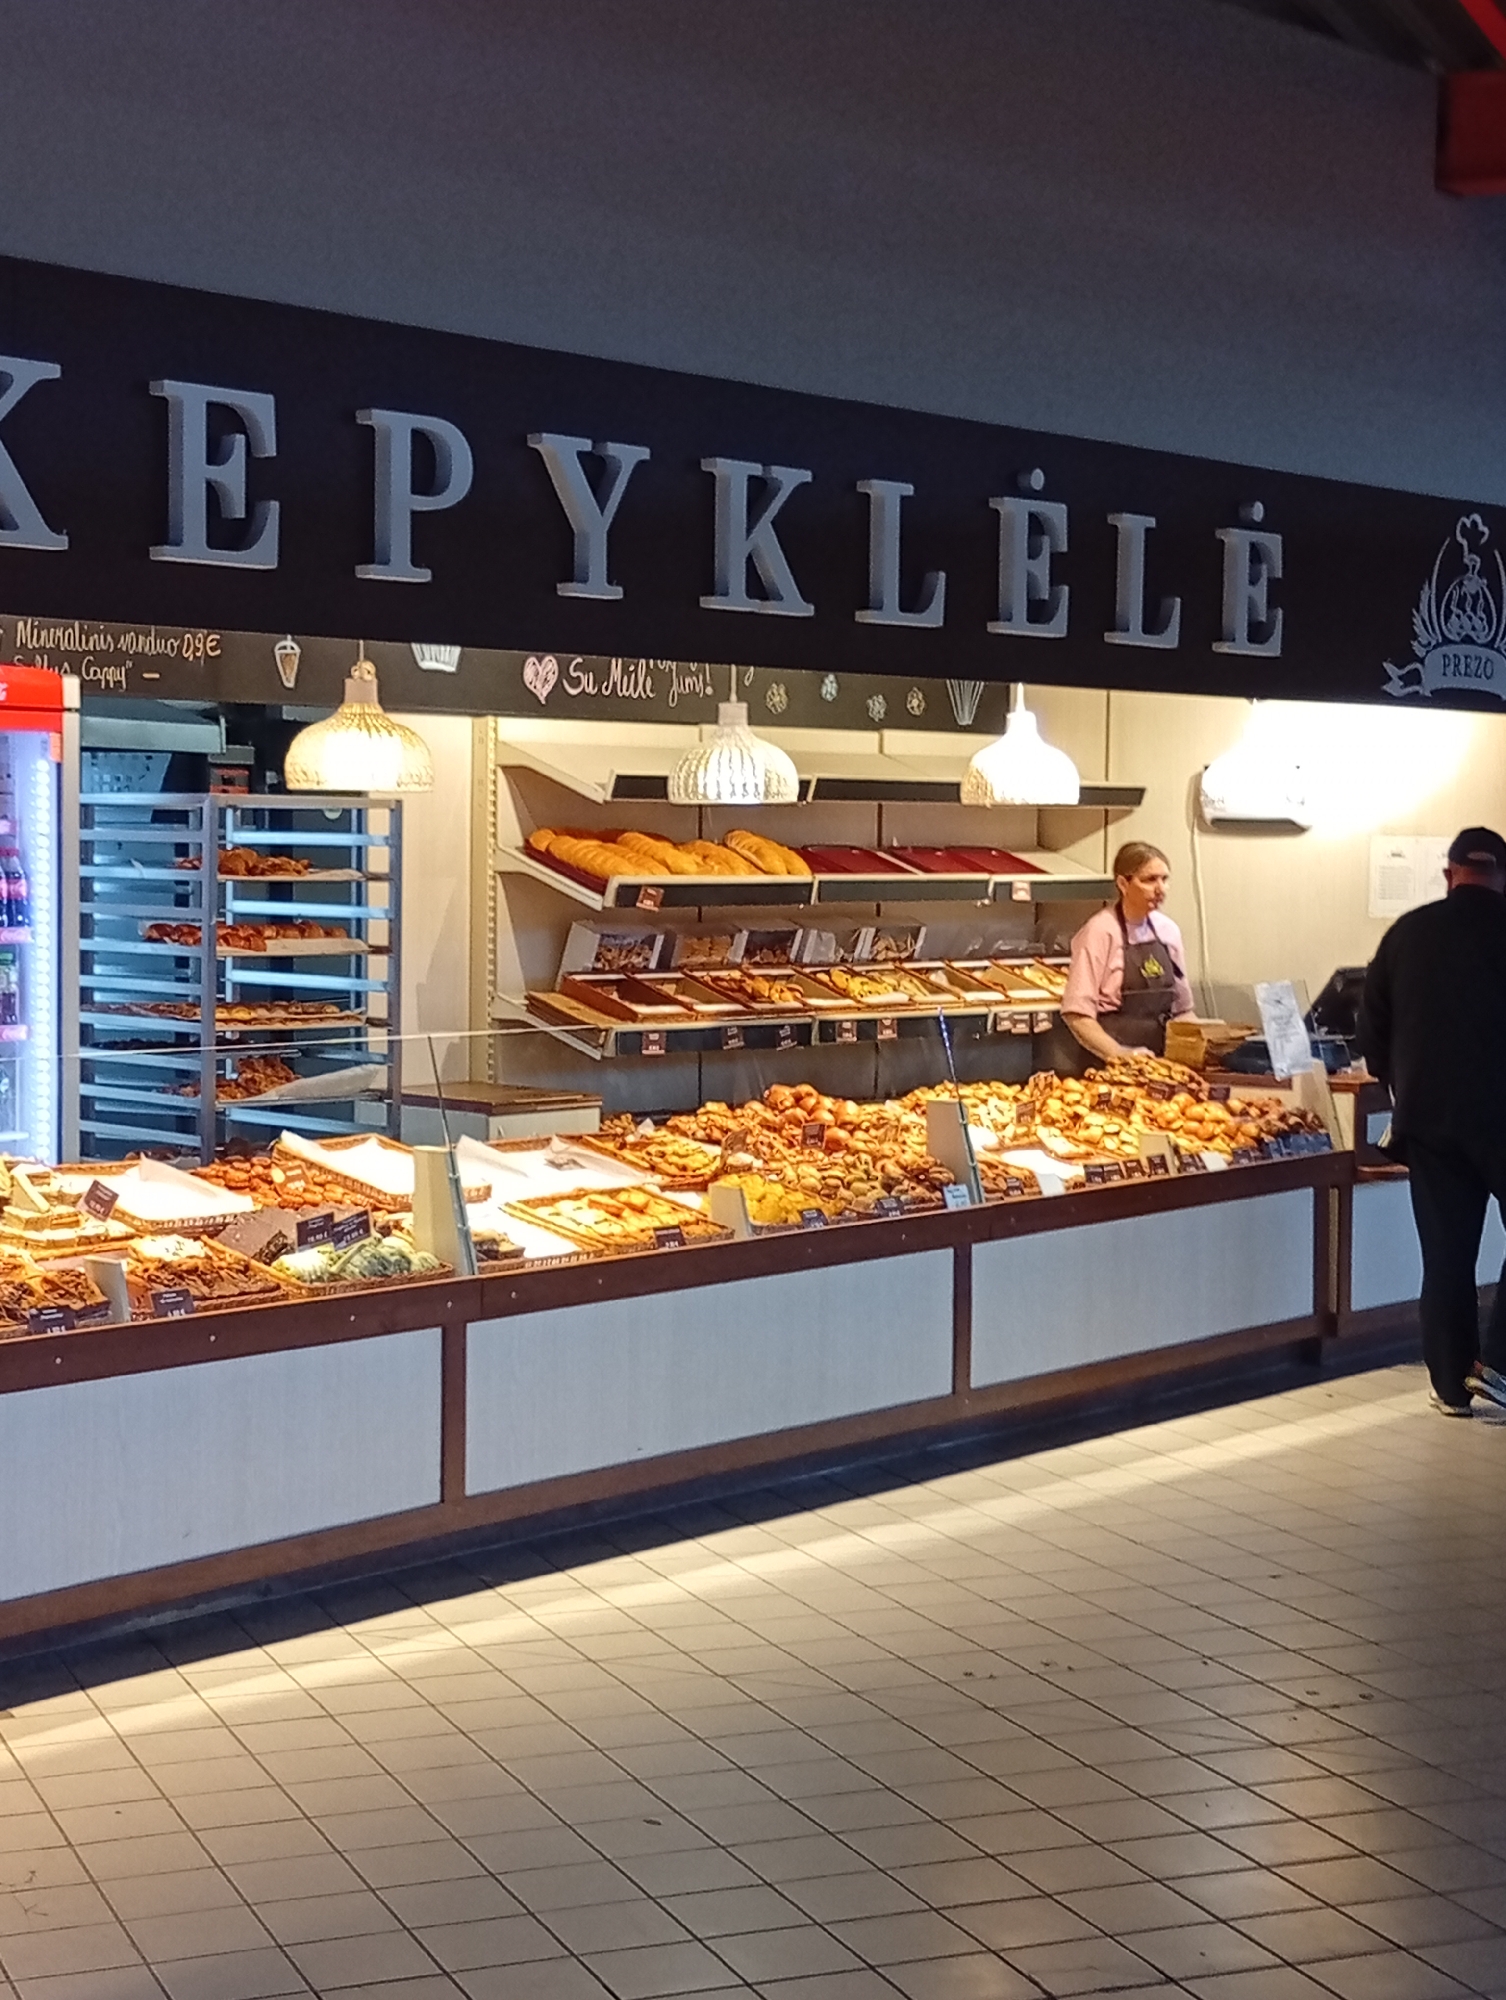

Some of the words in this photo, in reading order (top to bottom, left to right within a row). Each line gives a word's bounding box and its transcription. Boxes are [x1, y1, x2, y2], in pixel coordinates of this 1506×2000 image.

[16, 617, 115, 653] Mineralinis
[117, 626, 181, 658] vanduo
[563, 657, 599, 696] Su
[1442, 653, 1494, 680] PREZO
